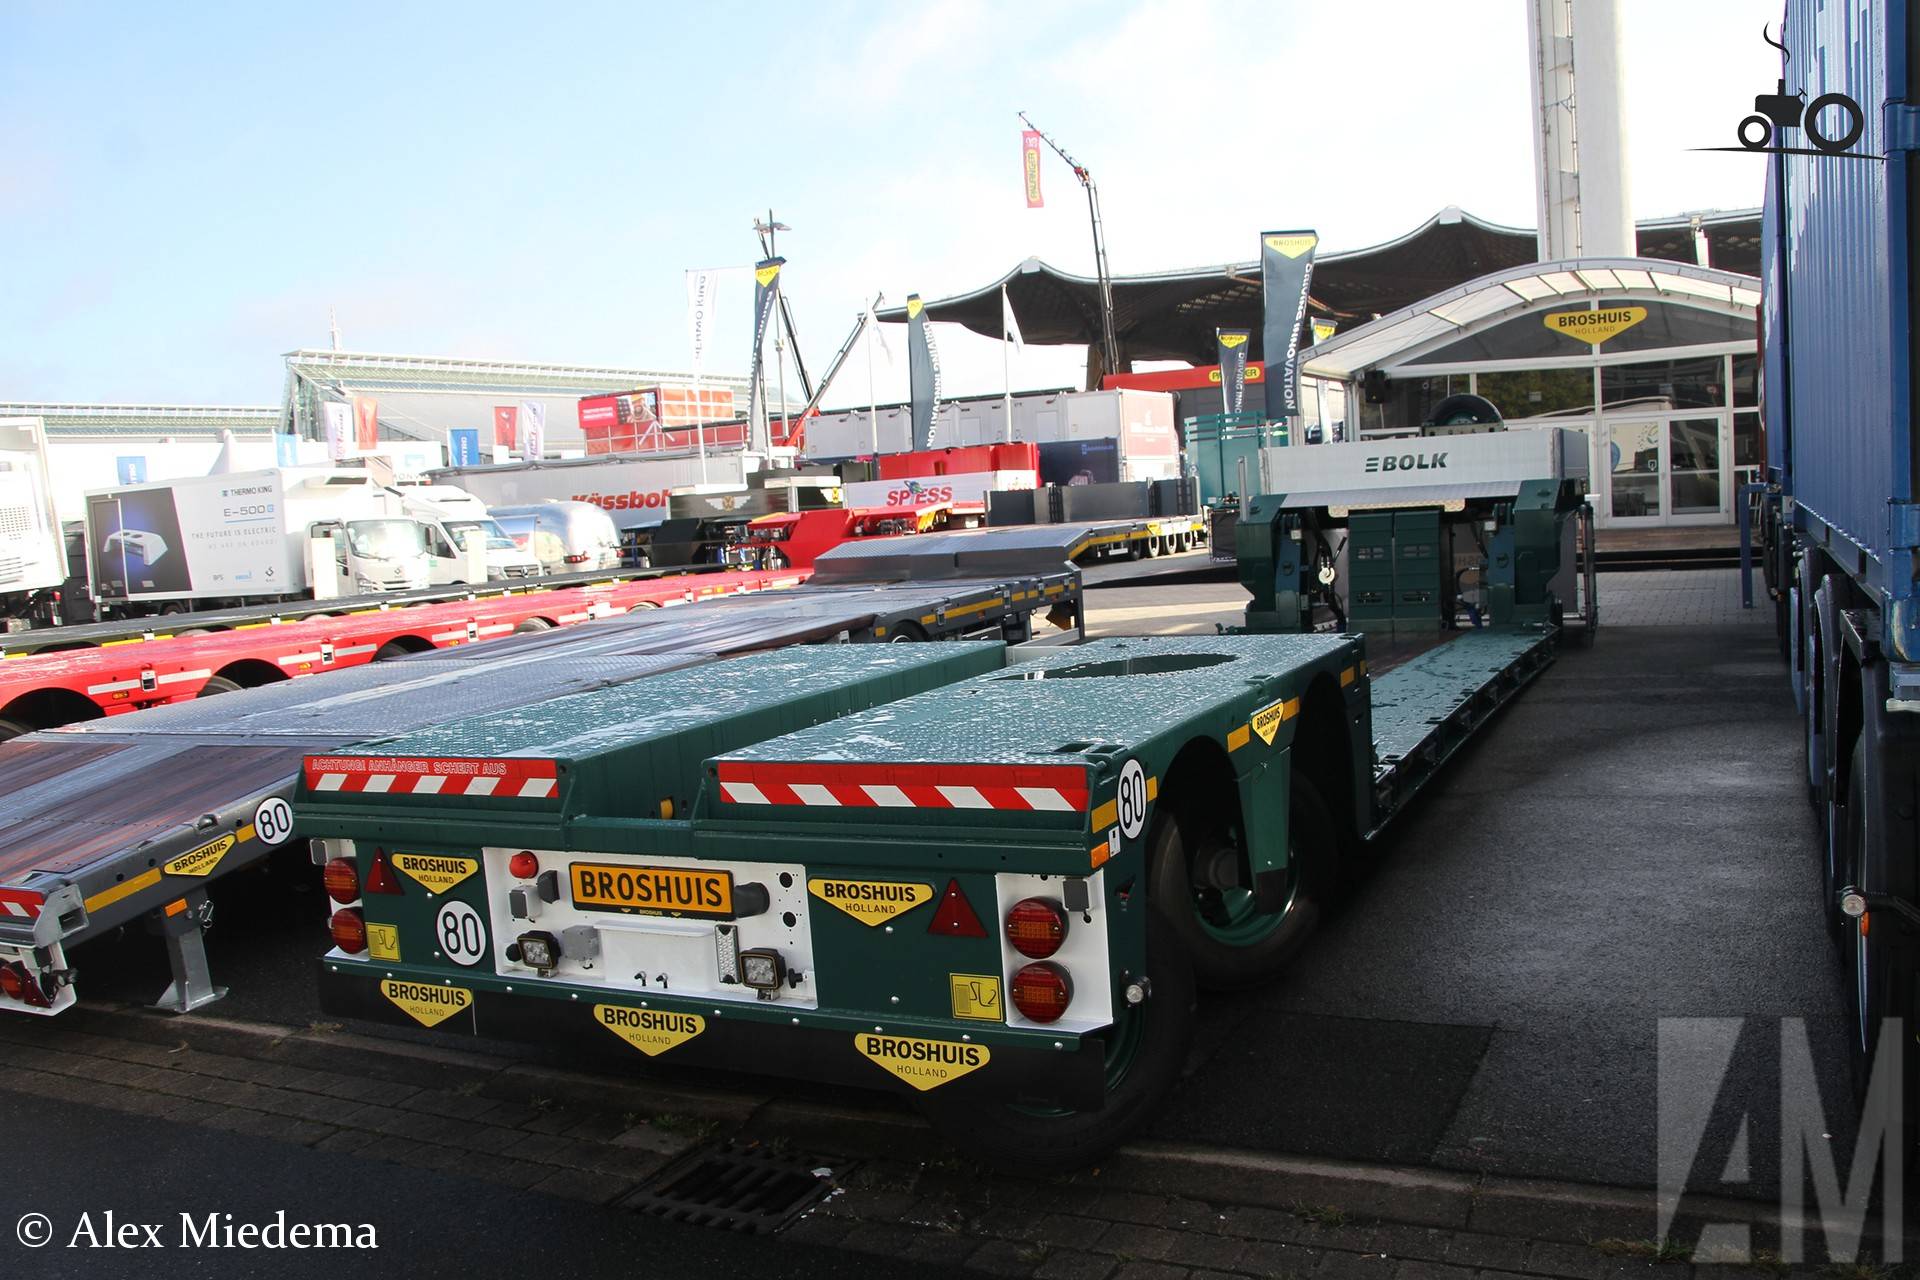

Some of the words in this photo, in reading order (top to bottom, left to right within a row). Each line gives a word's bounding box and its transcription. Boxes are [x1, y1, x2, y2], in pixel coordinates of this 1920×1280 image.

[1558, 311, 1631, 327] BROSHUIS
[1575, 325, 1616, 335] HOLLAND
[1284, 322, 1301, 409] INNOVATION
[927, 374, 941, 447] INNOVATION
[1382, 452, 1448, 471] BOLK
[230, 487, 256, 496] THERMO
[257, 485, 273, 493] KING
[1257, 707, 1281, 729] BROSHUIS
[368, 758, 429, 773] ANHÄNGER
[433, 761, 480, 774] SCHERT
[483, 762, 507, 775] AUS
[1121, 770, 1143, 829] 80
[258, 803, 291, 840] 80
[174, 839, 228, 872] BROSHUIS
[188, 856, 219, 874] HOLLAND
[402, 855, 467, 875] BROSHUIS
[418, 873, 454, 884] HOLLAND
[580, 870, 722, 907] BROSHUIS
[823, 882, 916, 903] BROSHUIS
[844, 902, 896, 915] HOLLAND
[442, 911, 480, 958] 80
[388, 981, 466, 1007] BROSHUIS
[409, 1005, 446, 1017] HOLLAND
[603, 1007, 697, 1034] BROSHUIS
[628, 1032, 671, 1045] HOLLAND
[866, 1036, 981, 1067] BROSHUIS
[896, 1064, 948, 1079] HOLLAND
